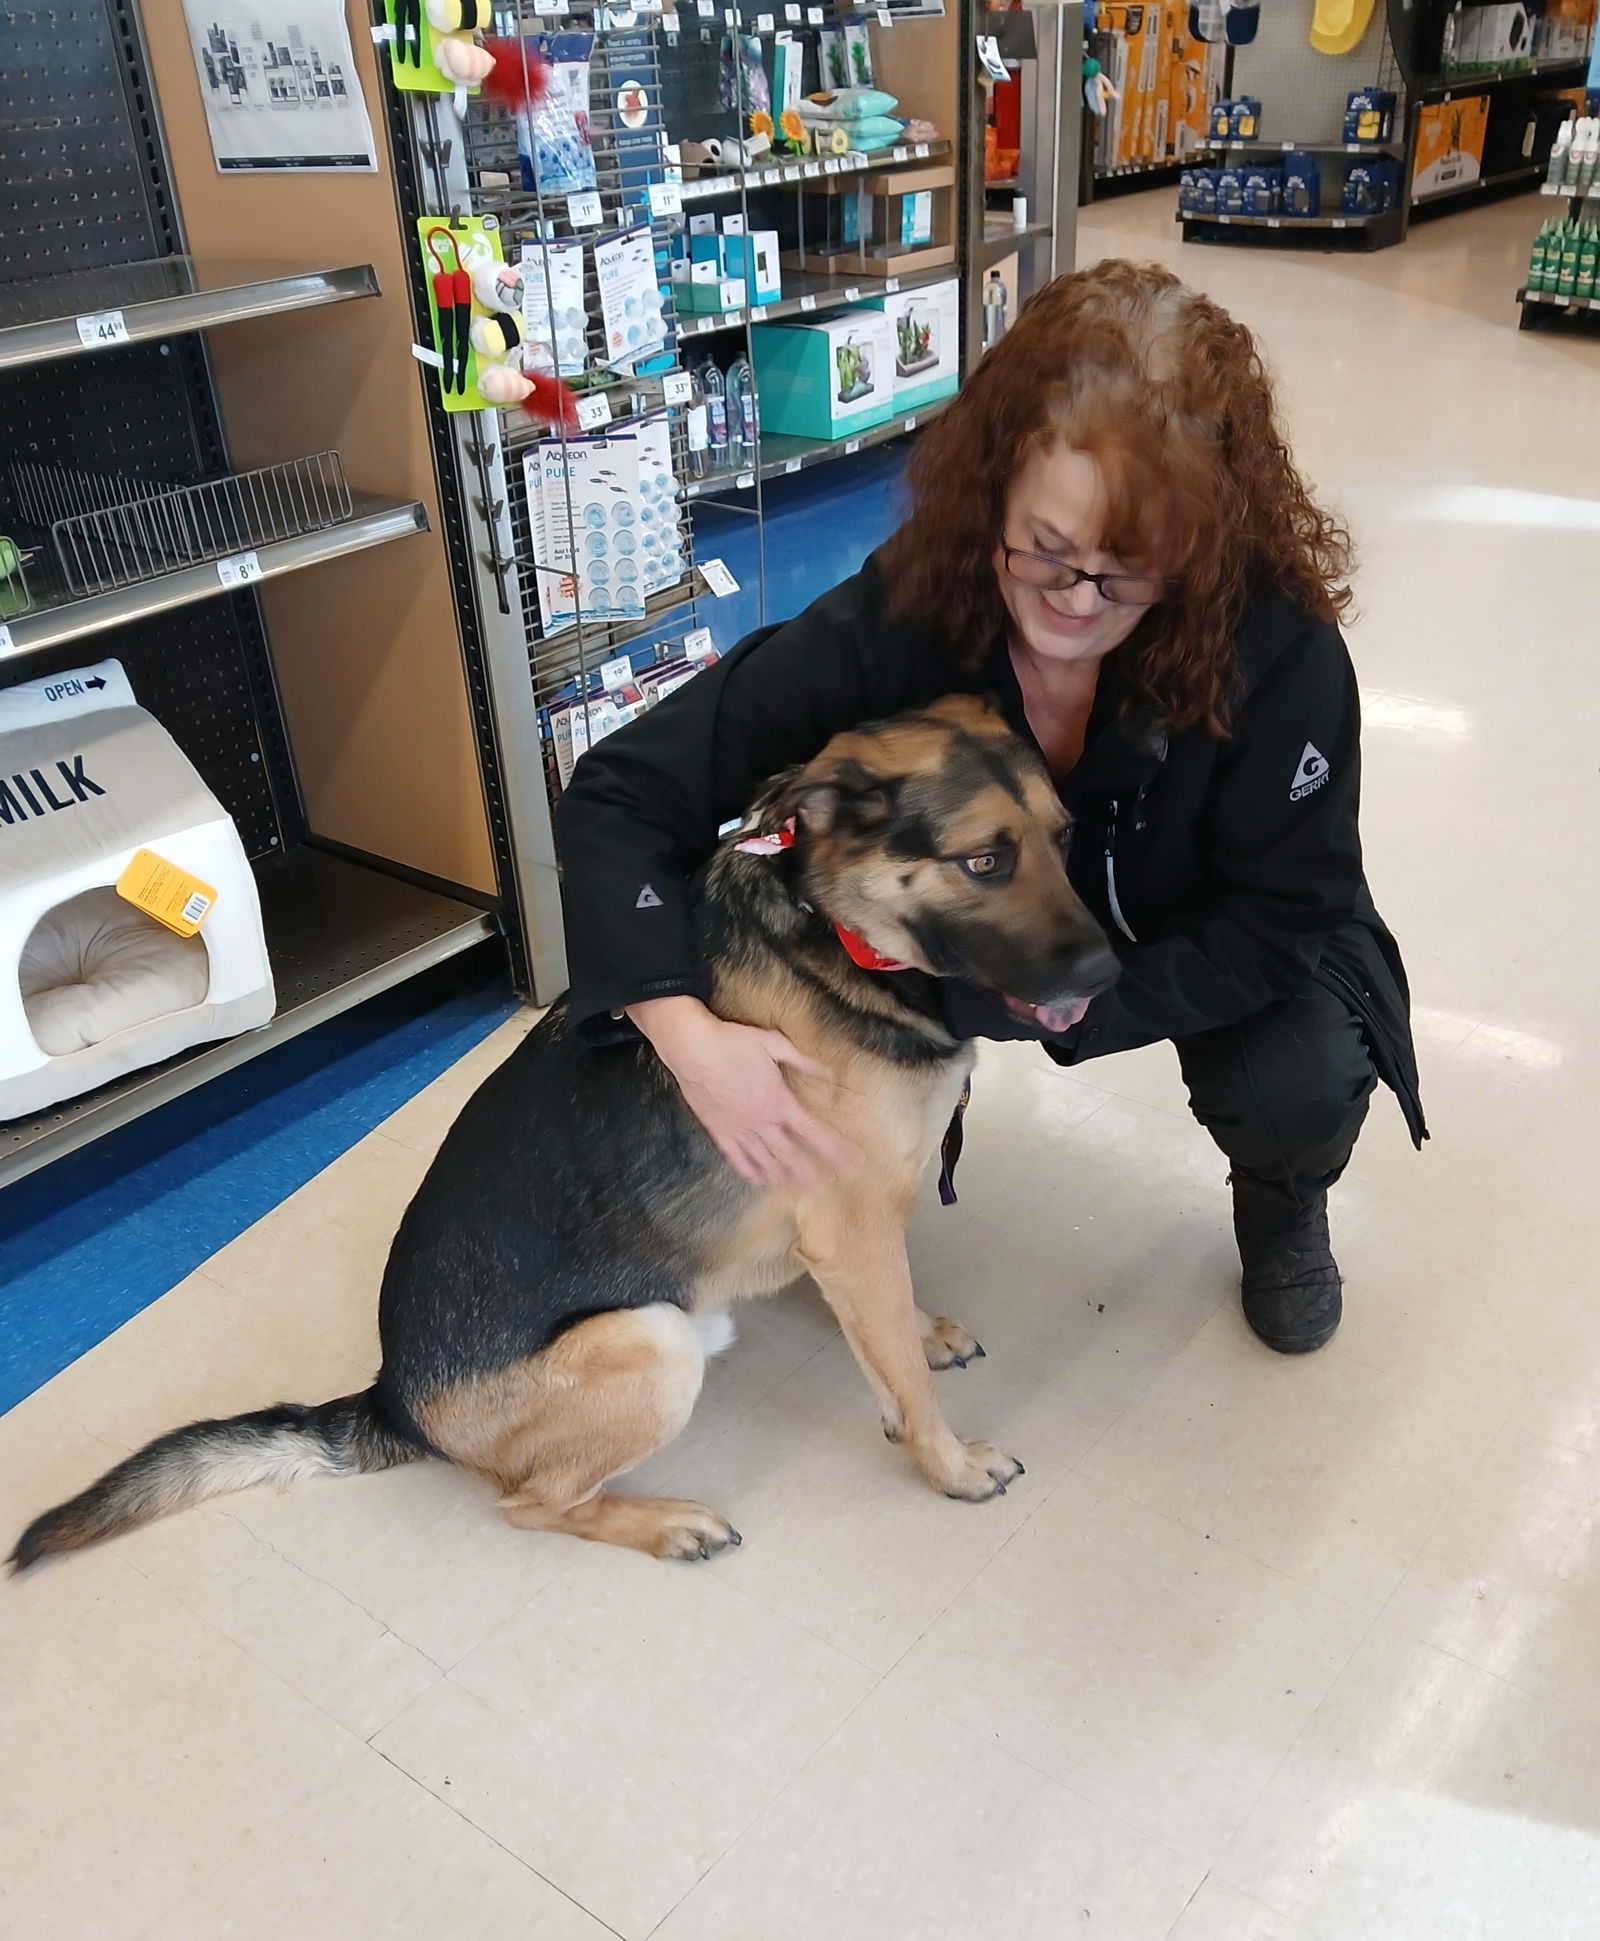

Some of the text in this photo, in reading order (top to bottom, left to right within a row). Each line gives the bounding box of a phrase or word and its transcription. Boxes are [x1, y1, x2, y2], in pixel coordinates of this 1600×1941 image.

[44, 678, 85, 702] OPEN
[575, 723, 595, 738] PUE
[0, 754, 107, 828] MILK
